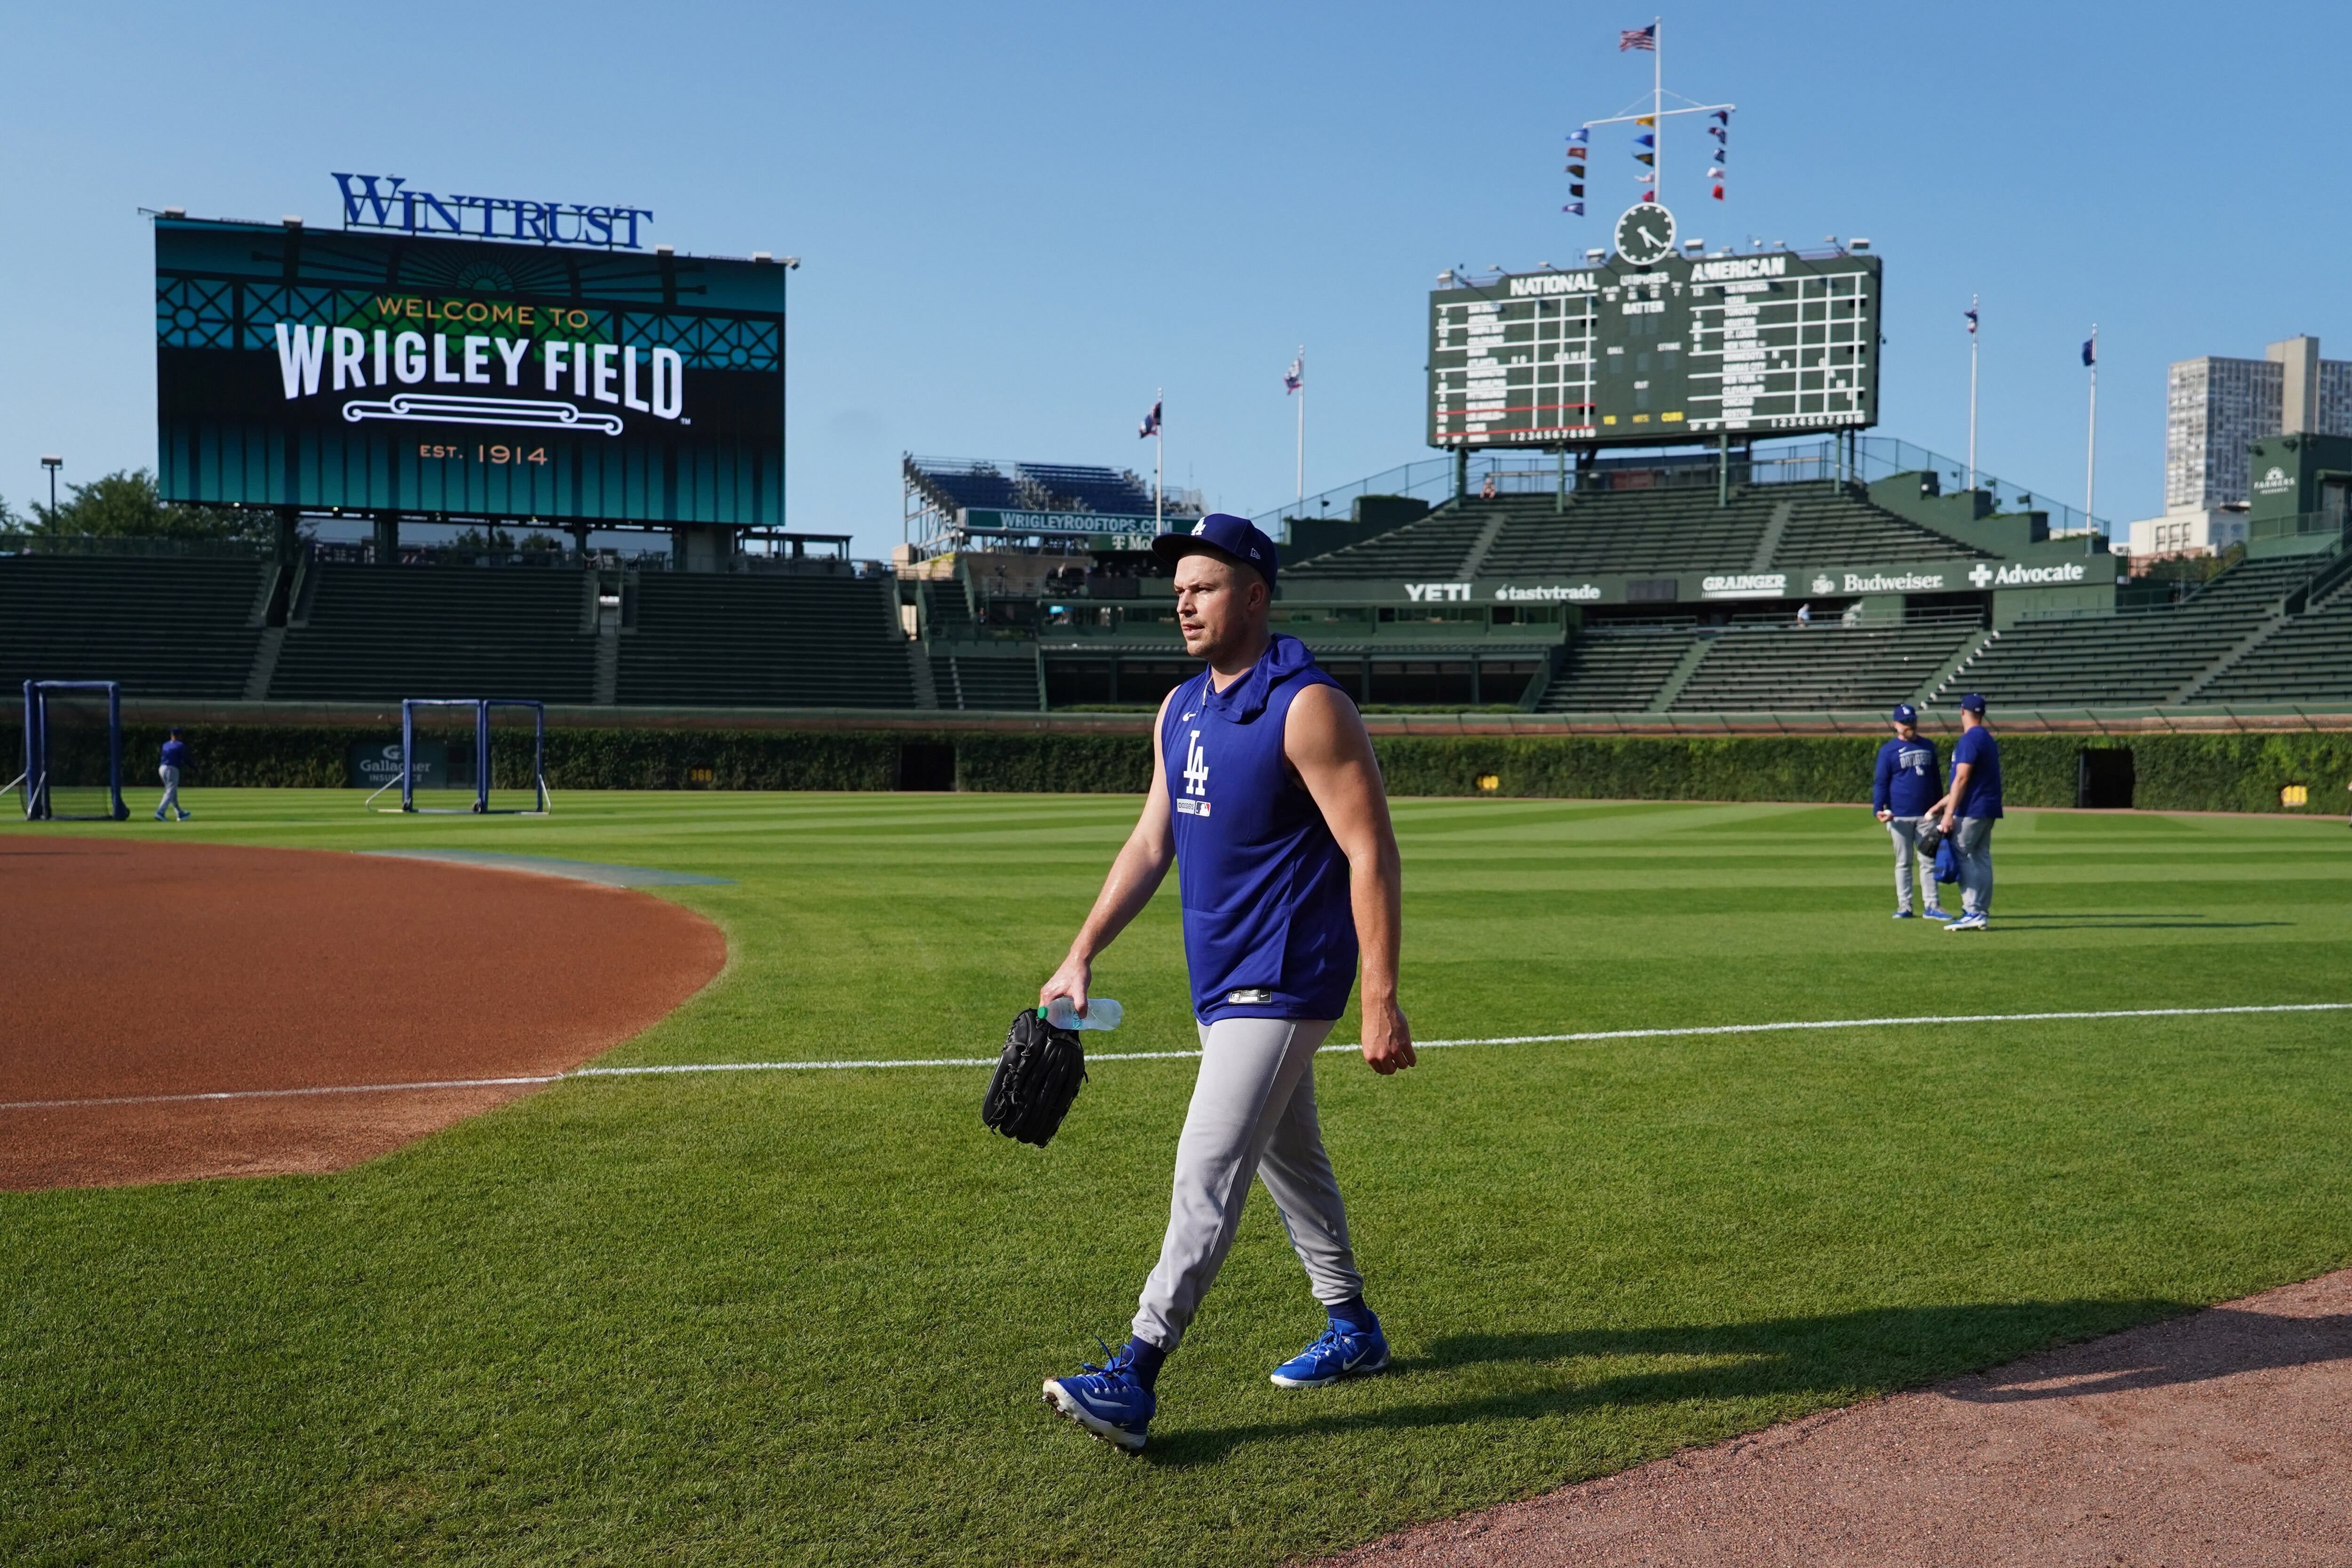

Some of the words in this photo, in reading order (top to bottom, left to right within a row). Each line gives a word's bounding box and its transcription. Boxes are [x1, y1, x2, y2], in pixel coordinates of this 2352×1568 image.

[331, 172, 653, 249] WINTRUST
[1690, 256, 1786, 282] AMERICAN
[1510, 272, 1599, 296] NATIONAL
[1724, 285, 1736, 294] SAN
[1736, 282, 1770, 293] FRANCISCO
[376, 296, 536, 325] WELCOME
[549, 308, 589, 329] TO
[1622, 301, 1665, 315] BATTER
[1724, 306, 1760, 317] TORONTO
[1724, 317, 1756, 328] HOUSTON
[1736, 329, 1758, 339] LOUIS
[1723, 351, 1766, 362] MINNESOTA
[1467, 358, 1498, 369] ATLANTA
[1750, 361, 1767, 371] CITY
[274, 323, 532, 400] WRIGLEY
[544, 340, 683, 420] FIELD
[1722, 384, 1765, 396] CLEVELAND
[1722, 397, 1755, 407] CHICAGO
[1661, 411, 1684, 422] CUBS
[1722, 407, 1753, 419] BOSTON
[1465, 423, 1487, 432] CUBS
[1771, 419, 1777, 428] 1
[1780, 418, 1788, 427] 2
[1789, 417, 1797, 427] 3
[1798, 417, 1806, 426] 4
[1808, 416, 1816, 426] 5
[1817, 416, 1825, 426] 6
[1827, 415, 1834, 425] 7
[1836, 415, 1844, 425] 8
[1845, 414, 1853, 424] 9
[1854, 414, 1865, 424] 10
[1510, 432, 1516, 441] 1
[1518, 432, 1526, 441] 2
[1527, 431, 1535, 440] 3
[1535, 431, 1542, 440] 4
[1544, 430, 1551, 439] 5
[1552, 430, 1560, 439] 6
[1561, 429, 1569, 438] 7
[1569, 429, 1577, 438] 8
[1578, 428, 1585, 438] 9
[1586, 428, 1596, 437] 10
[420, 444, 463, 459] EST.
[477, 444, 548, 466] 1914
[2254, 477, 2295, 490] FARMERS
[1000, 511, 1173, 533] WRIGLEYROOFTOPS.COM
[1995, 563, 2082, 585] Advocate
[1702, 574, 1785, 591] GRAINGER
[1843, 572, 1940, 592] Budweiser
[1405, 583, 1472, 602] YETI
[1184, 730, 1208, 796] LA
